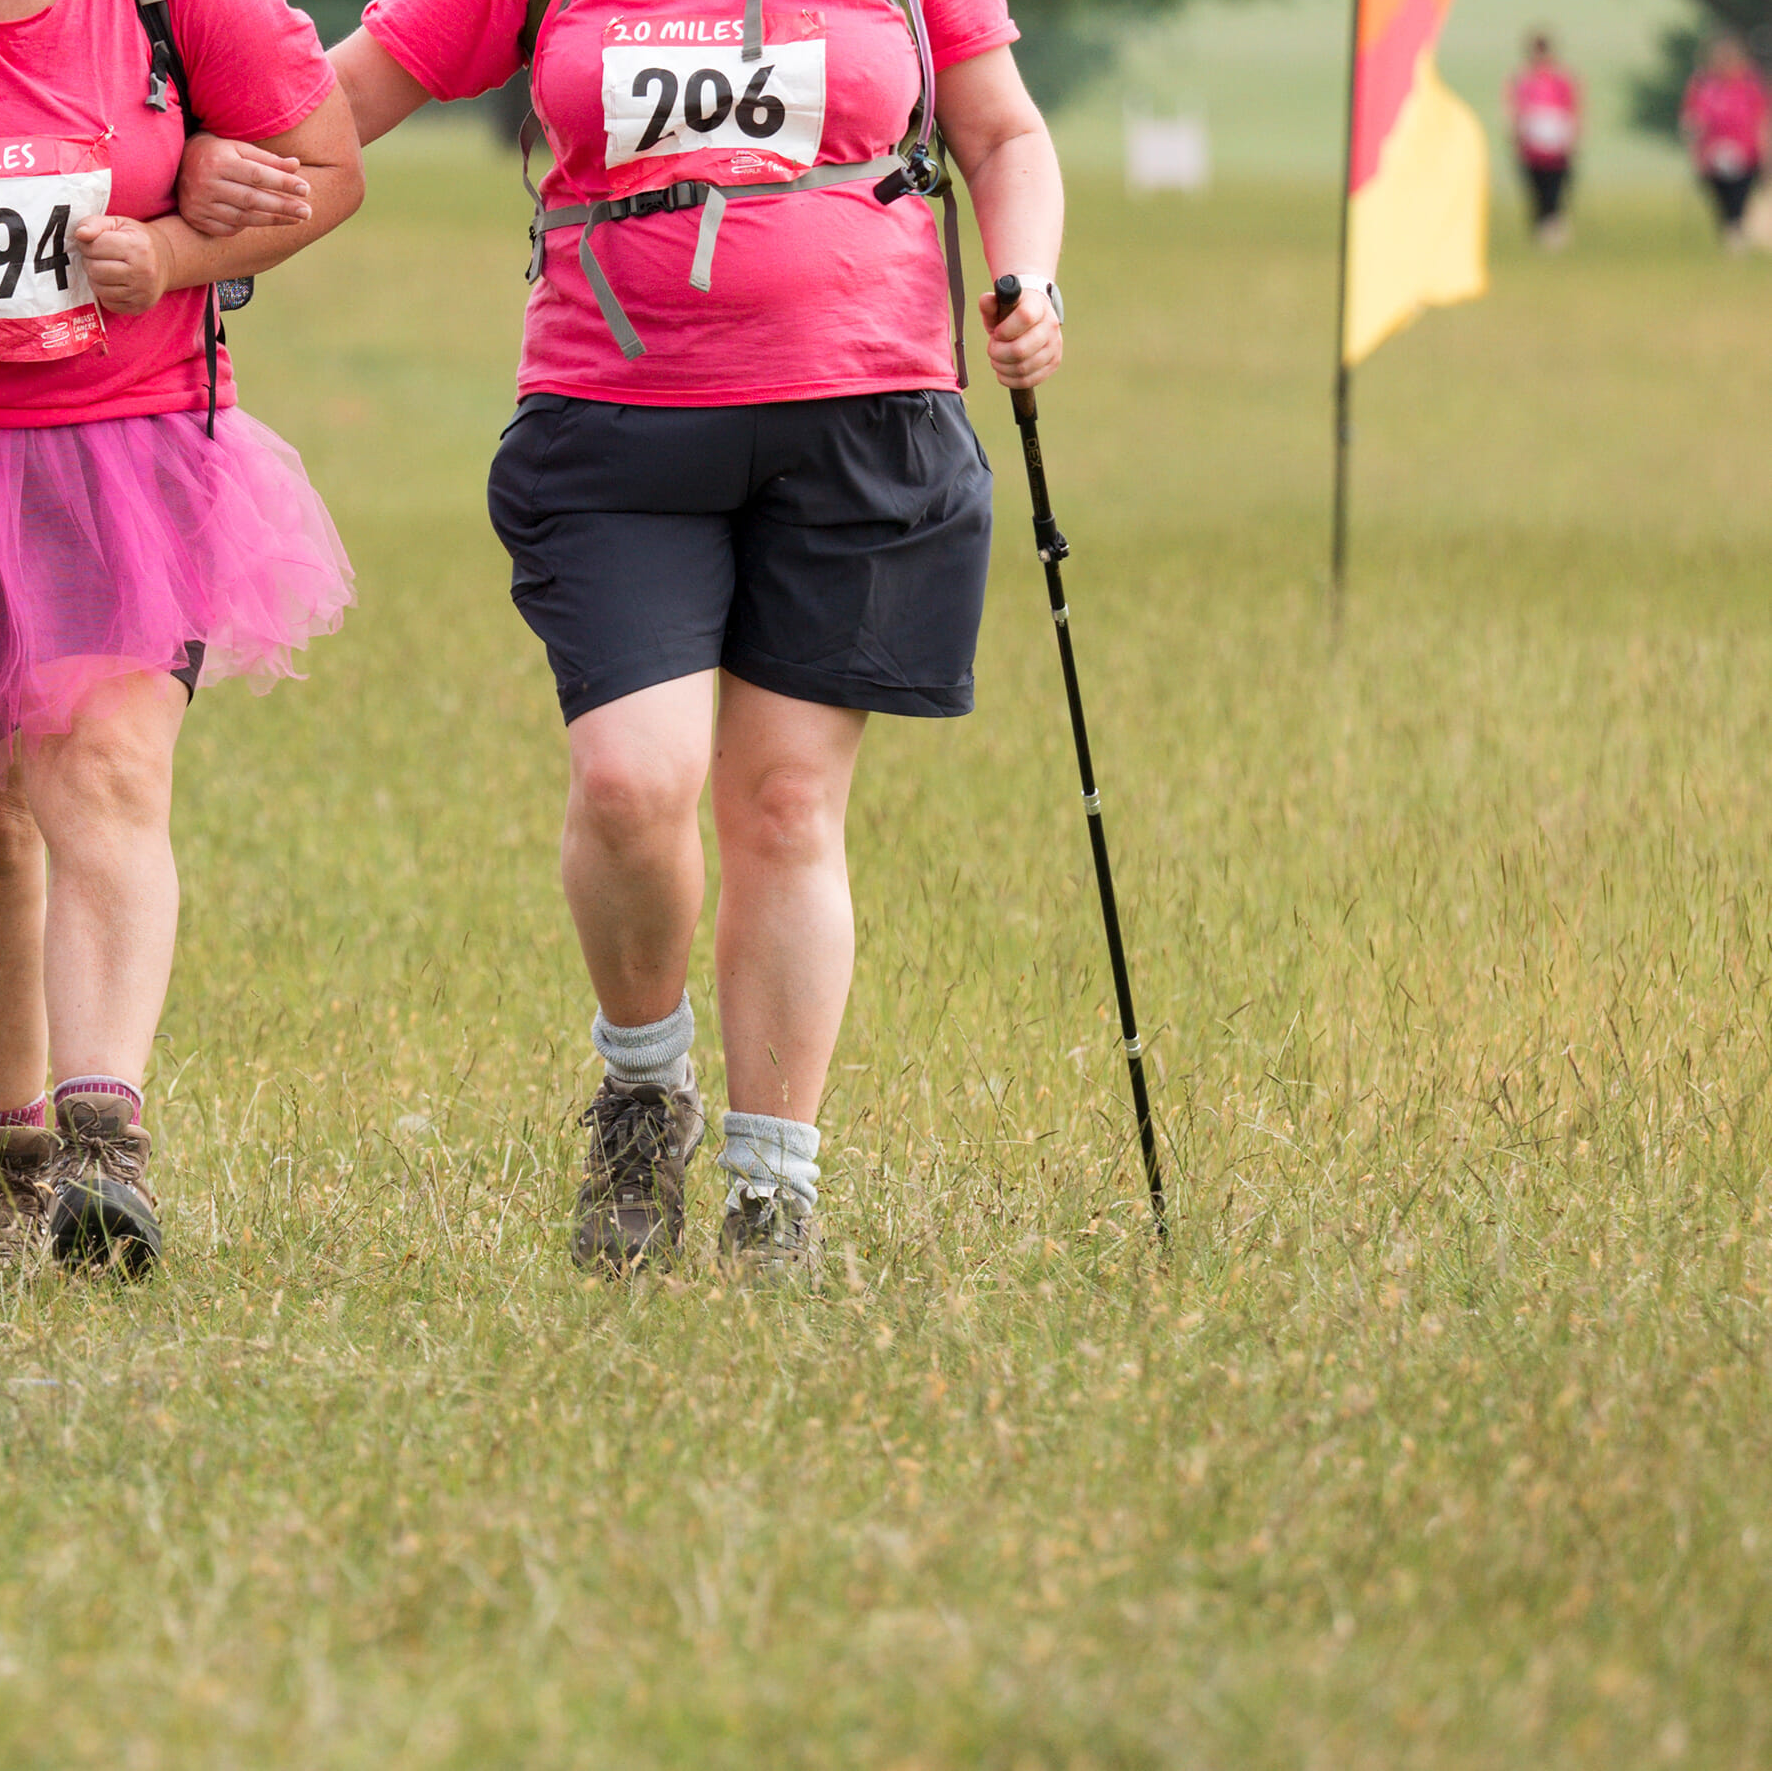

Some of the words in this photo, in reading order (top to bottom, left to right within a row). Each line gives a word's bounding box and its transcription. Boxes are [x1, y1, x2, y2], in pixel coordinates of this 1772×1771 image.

[614, 21, 651, 42] 20
[660, 19, 744, 41] MILES
[632, 64, 786, 152] 206
